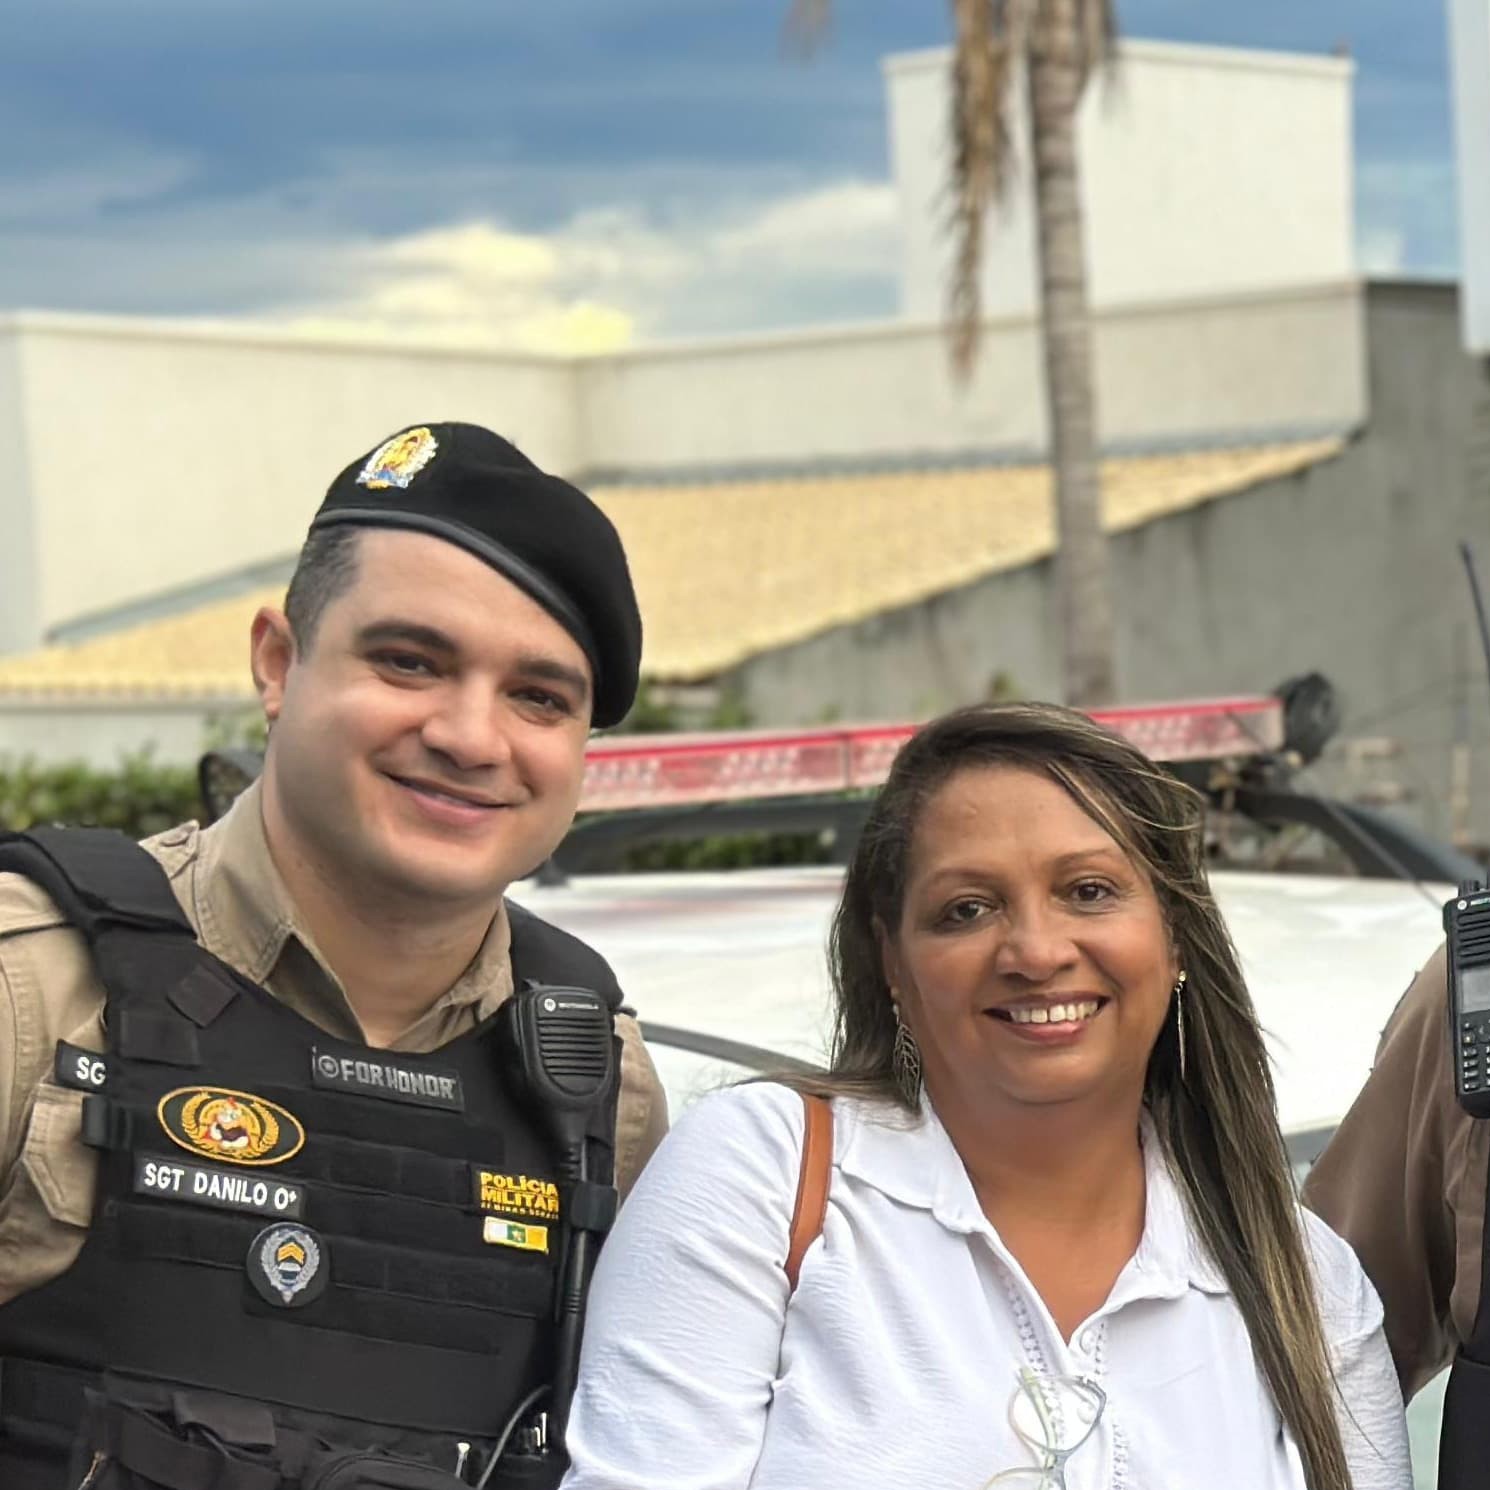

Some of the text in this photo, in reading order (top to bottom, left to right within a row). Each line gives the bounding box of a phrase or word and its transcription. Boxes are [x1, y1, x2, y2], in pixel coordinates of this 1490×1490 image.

[76, 1056, 106, 1085] SG
[144, 1163, 184, 1191] SGT
[193, 1172, 268, 1206] DANILO
[481, 1187, 559, 1212] MILITAR
